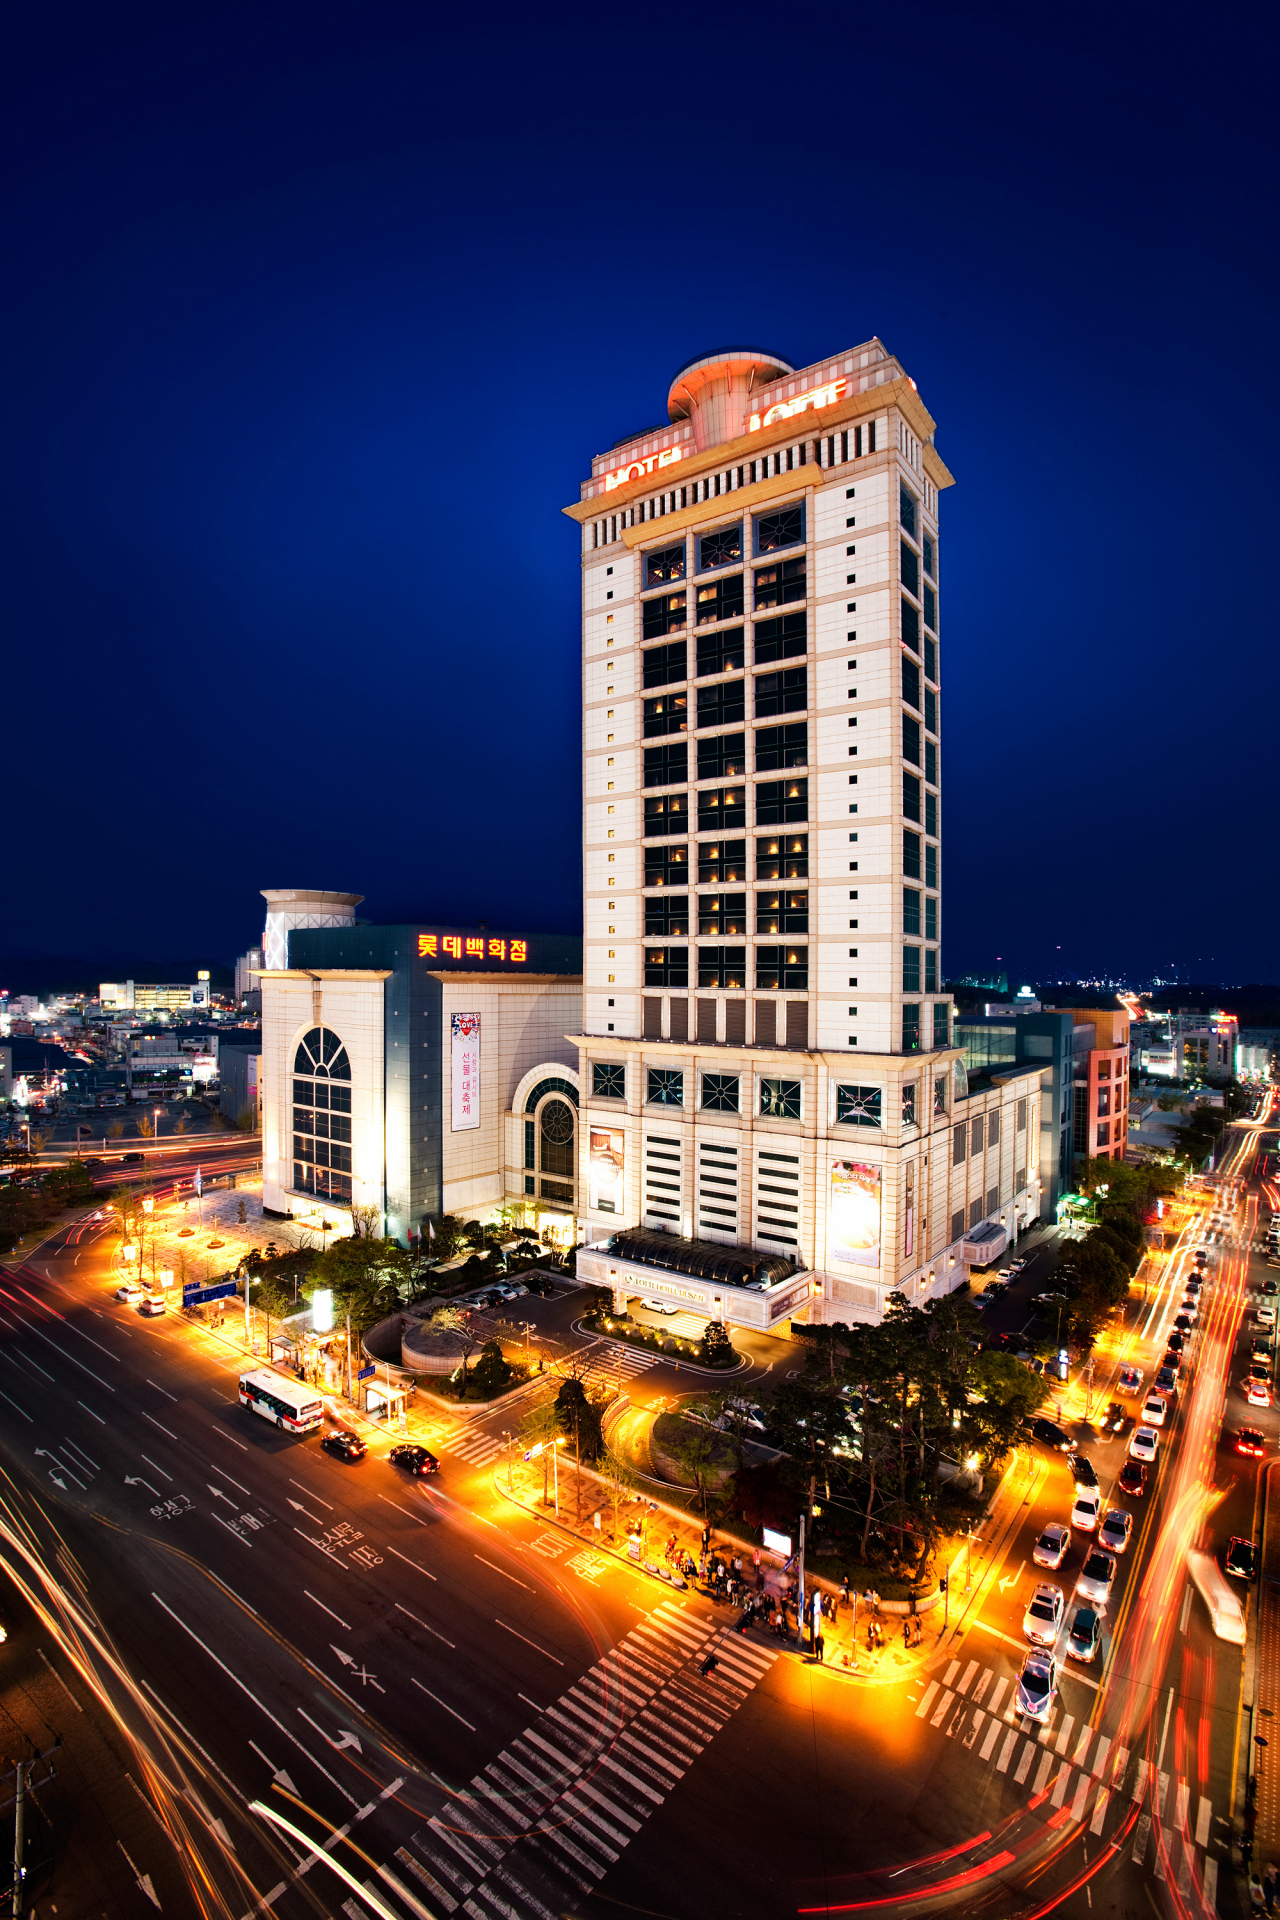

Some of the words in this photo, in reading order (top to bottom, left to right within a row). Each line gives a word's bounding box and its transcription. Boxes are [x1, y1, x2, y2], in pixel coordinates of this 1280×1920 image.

[418, 934, 527, 962] 롯데백화점
[462, 1052, 471, 1076] 선물
[462, 1080, 471, 1115] 대축제
[679, 1289, 704, 1302] ULSAN
[311, 1521, 365, 1553] 농수산물
[530, 1531, 575, 1558] CCTV
[348, 1545, 384, 1571] 시장
